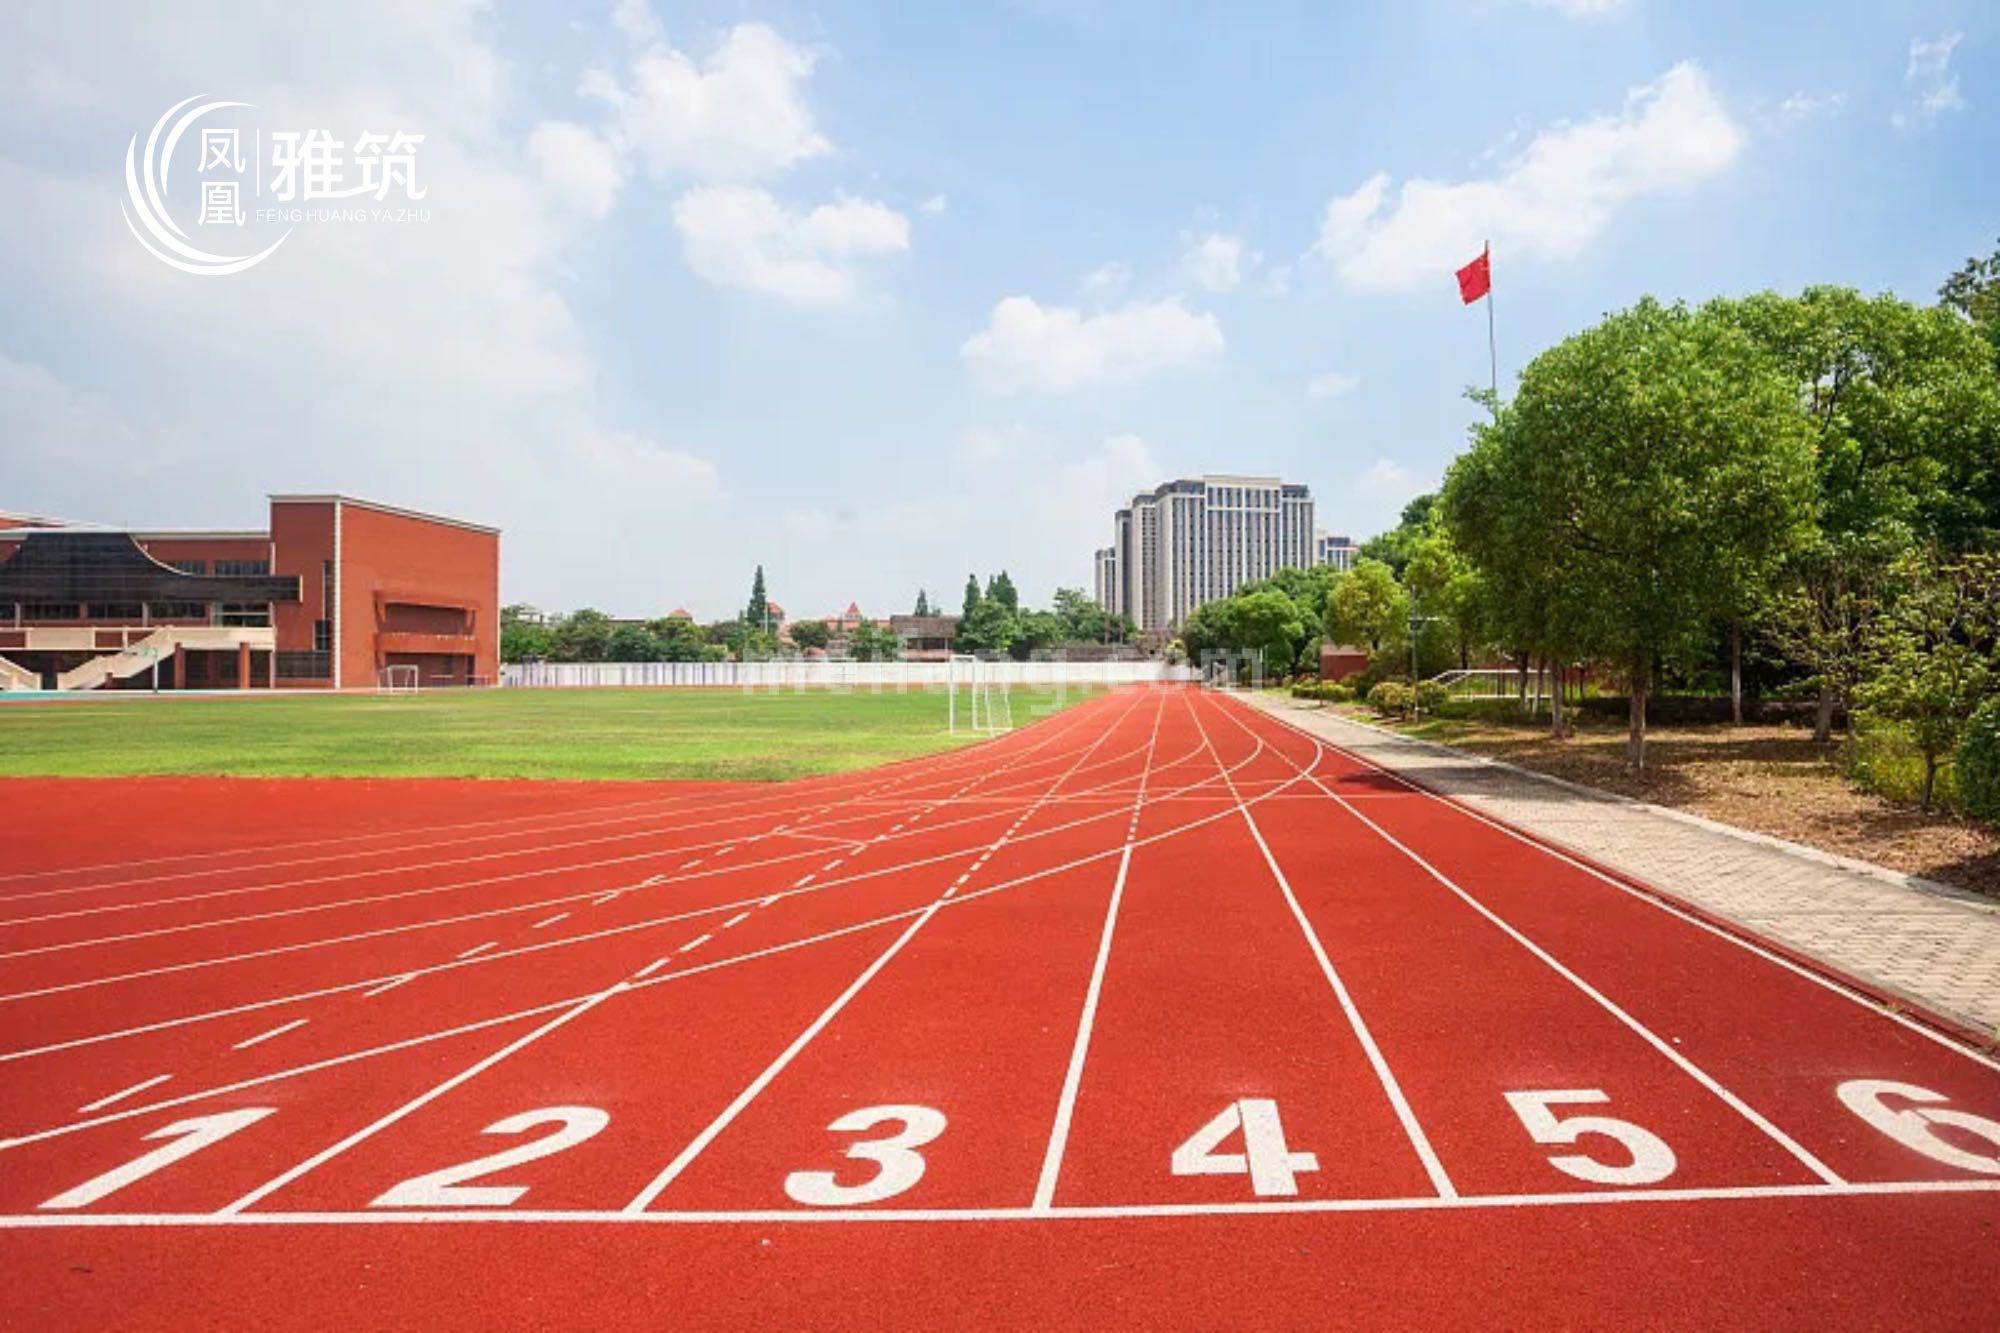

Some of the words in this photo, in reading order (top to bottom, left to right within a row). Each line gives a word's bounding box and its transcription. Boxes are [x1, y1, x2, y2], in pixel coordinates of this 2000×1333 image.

[37, 1107, 278, 1209] 1
[368, 1105, 611, 1206] 2
[784, 1104, 948, 1206] 3
[1171, 1098, 1321, 1197] 4
[1502, 1088, 1678, 1186] 5
[1836, 1079, 2000, 1175] 6
